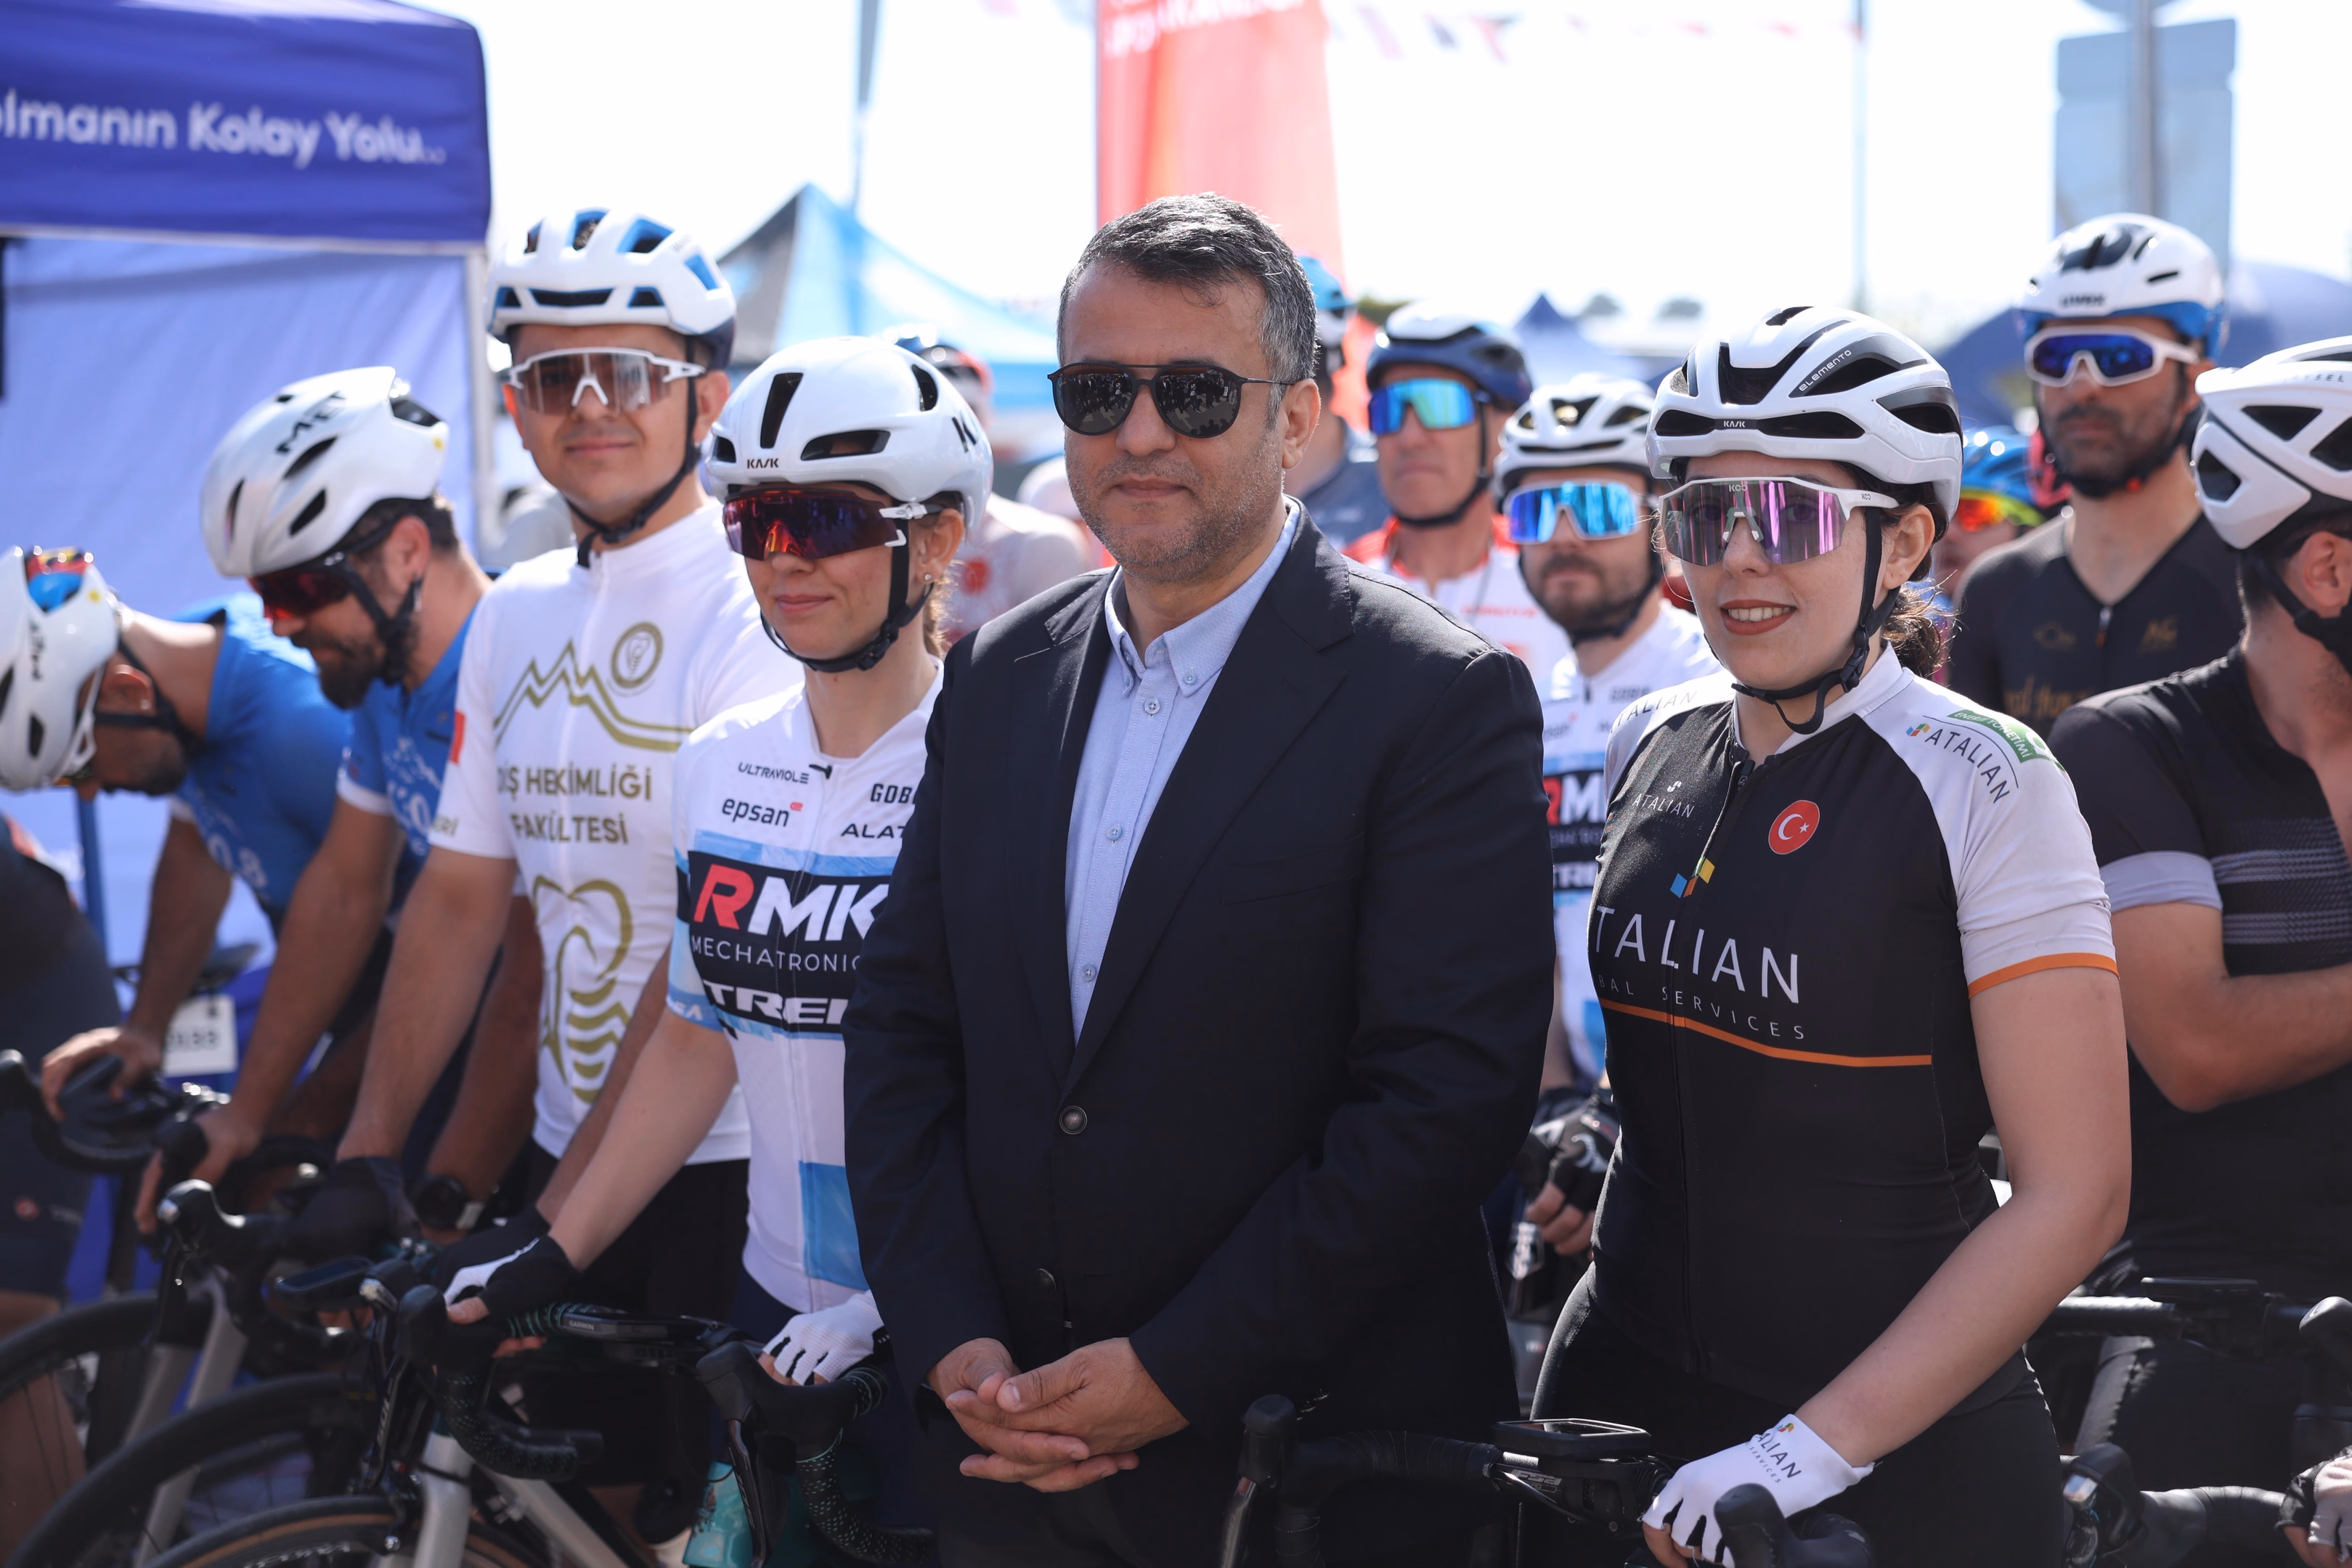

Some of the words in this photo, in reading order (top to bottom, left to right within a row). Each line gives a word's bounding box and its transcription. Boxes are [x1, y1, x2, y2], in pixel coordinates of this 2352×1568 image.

[0, 88, 177, 150] lmanın
[187, 101, 320, 169] Kolay
[747, 458, 778, 469] KASK
[1611, 691, 1697, 734] TALIAN
[526, 760, 652, 801] HEKİMLİĞİ
[738, 762, 810, 784] ULTRAVIOLE
[1924, 728, 2010, 804] ATALIAN
[871, 783, 916, 804] GOB
[1632, 793, 1695, 818] ATALIAN
[510, 809, 629, 844] FAKÜLTESİ
[722, 799, 789, 827] epsan
[693, 864, 890, 941] RMK
[1596, 905, 1799, 1003] TALIAN
[1662, 987, 1804, 1040] SERVICES
[1749, 1447, 1781, 1483] SERVICES
